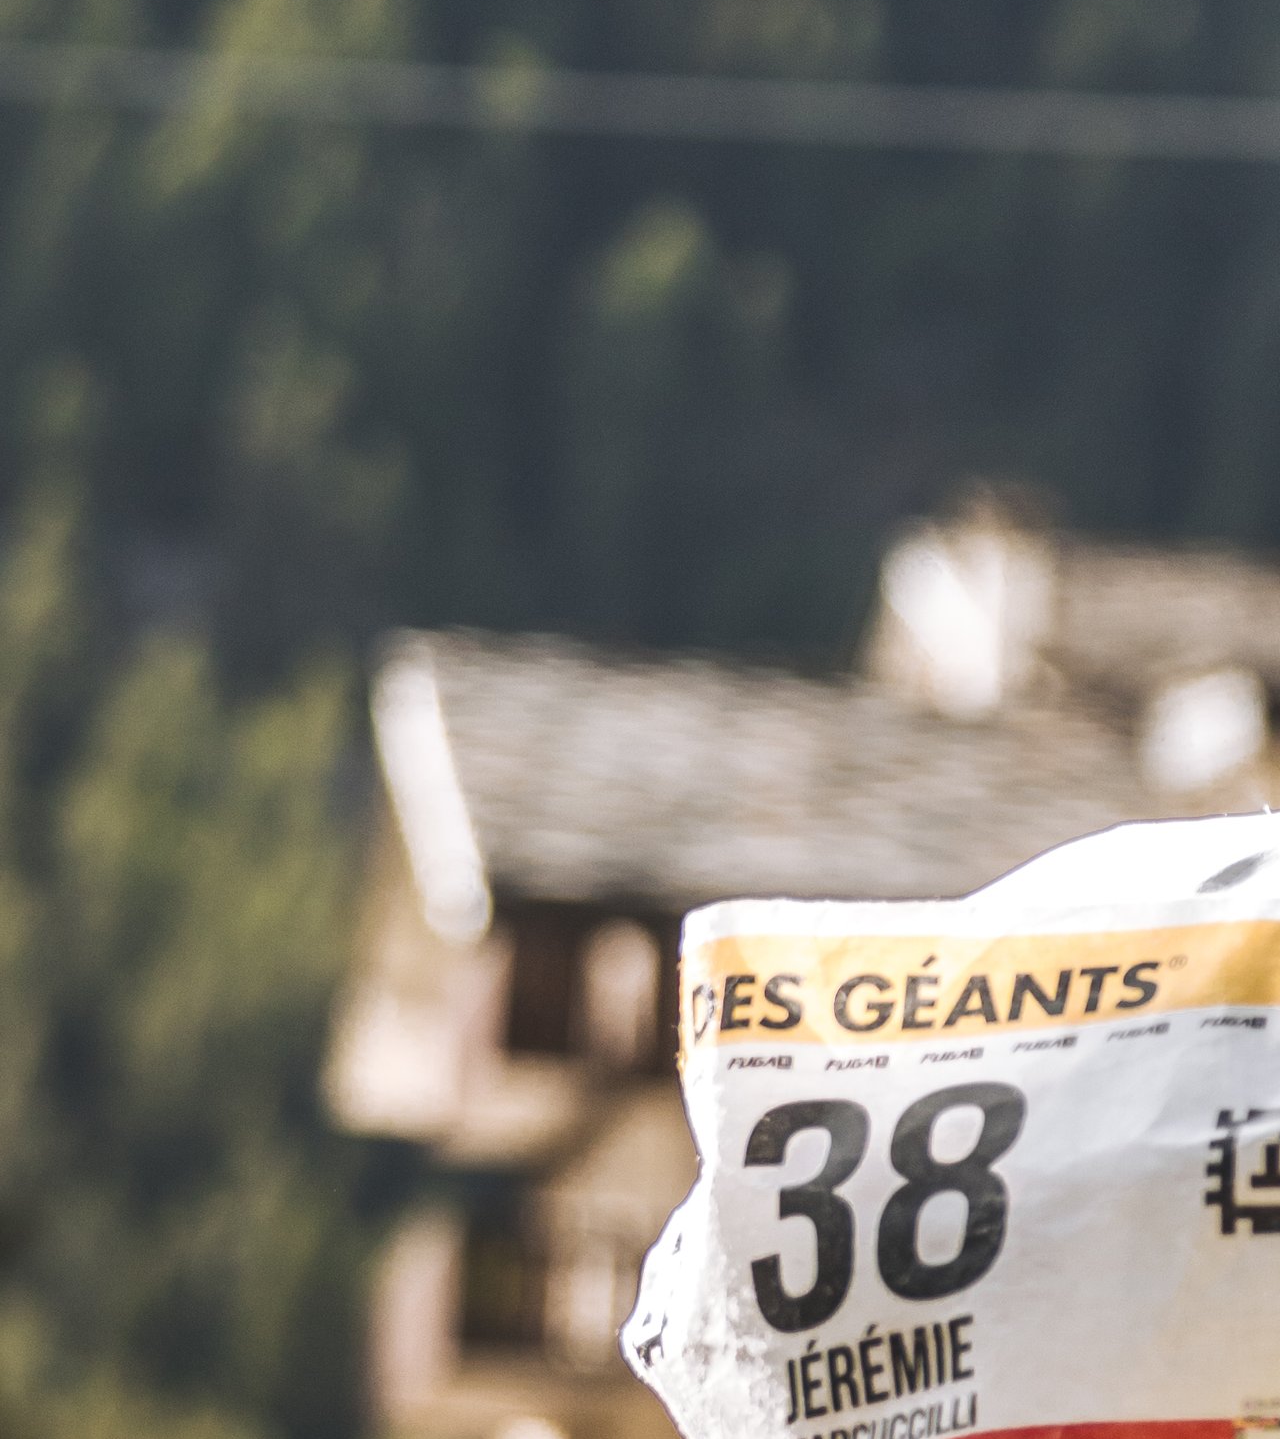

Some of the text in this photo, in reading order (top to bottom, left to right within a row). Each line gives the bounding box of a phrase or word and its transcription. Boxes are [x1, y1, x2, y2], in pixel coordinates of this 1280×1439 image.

[833, 955, 1160, 1032] GÉANTS
[744, 1081, 1028, 1333] 38
[787, 1314, 974, 1425] JÉRÉMIE
